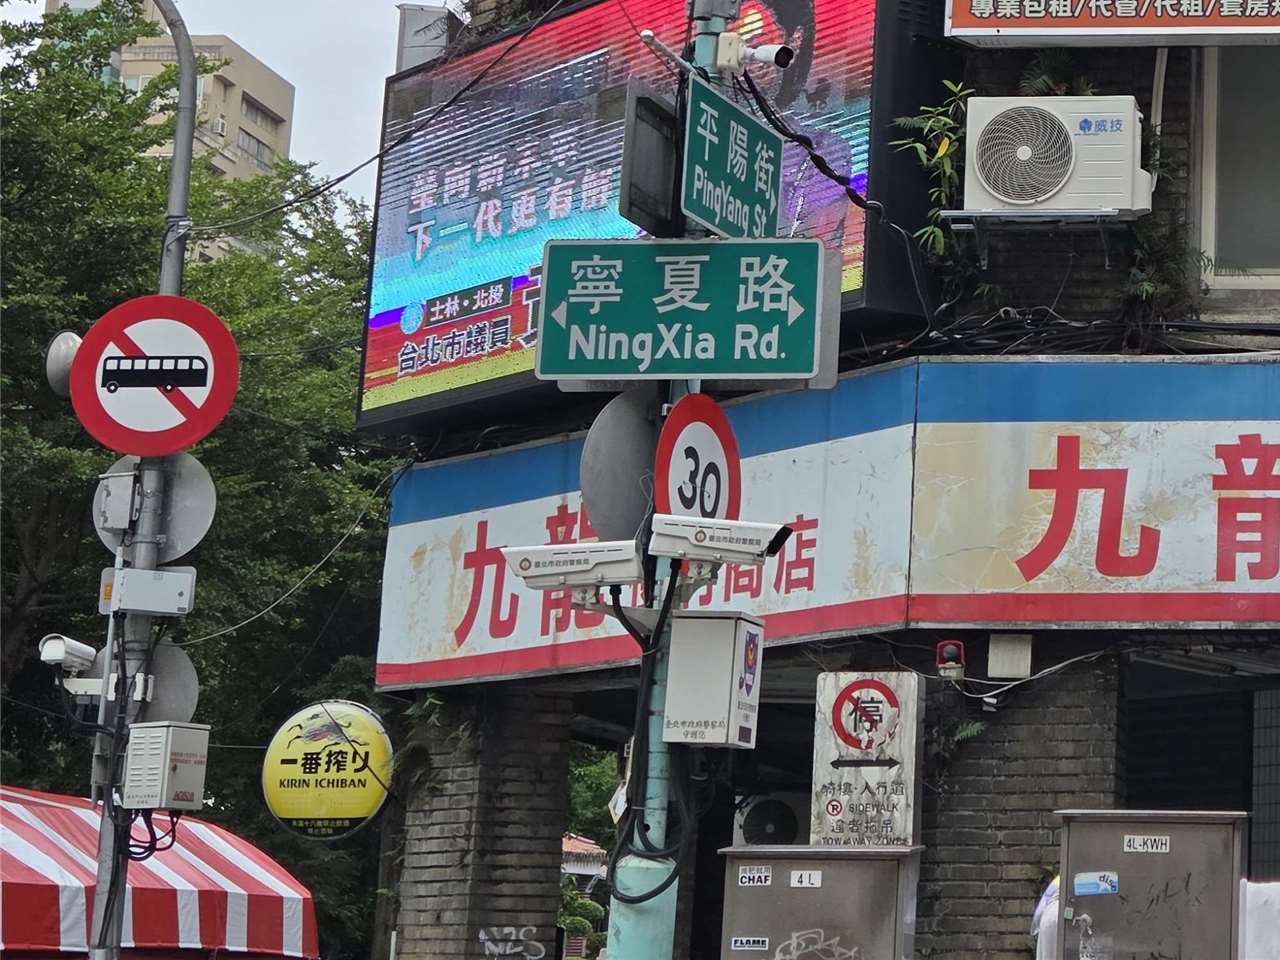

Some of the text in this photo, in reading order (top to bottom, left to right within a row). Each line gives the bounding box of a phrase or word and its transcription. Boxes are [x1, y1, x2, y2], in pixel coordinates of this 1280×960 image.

[697, 101, 776, 200] 平陽街
[693, 165, 750, 237] PingYang
[567, 254, 795, 316] 寧夏路
[397, 315, 512, 377] 台北市議員
[568, 322, 786, 370] NingXia Rd.
[677, 445, 721, 518] 30
[279, 778, 367, 788] KIRIN ICHIBAN
[848, 802, 899, 814] SIDEWALK
[1125, 837, 1169, 852] 4L-KWH
[740, 874, 770, 885] CHAF
[734, 938, 767, 947] FLAME
